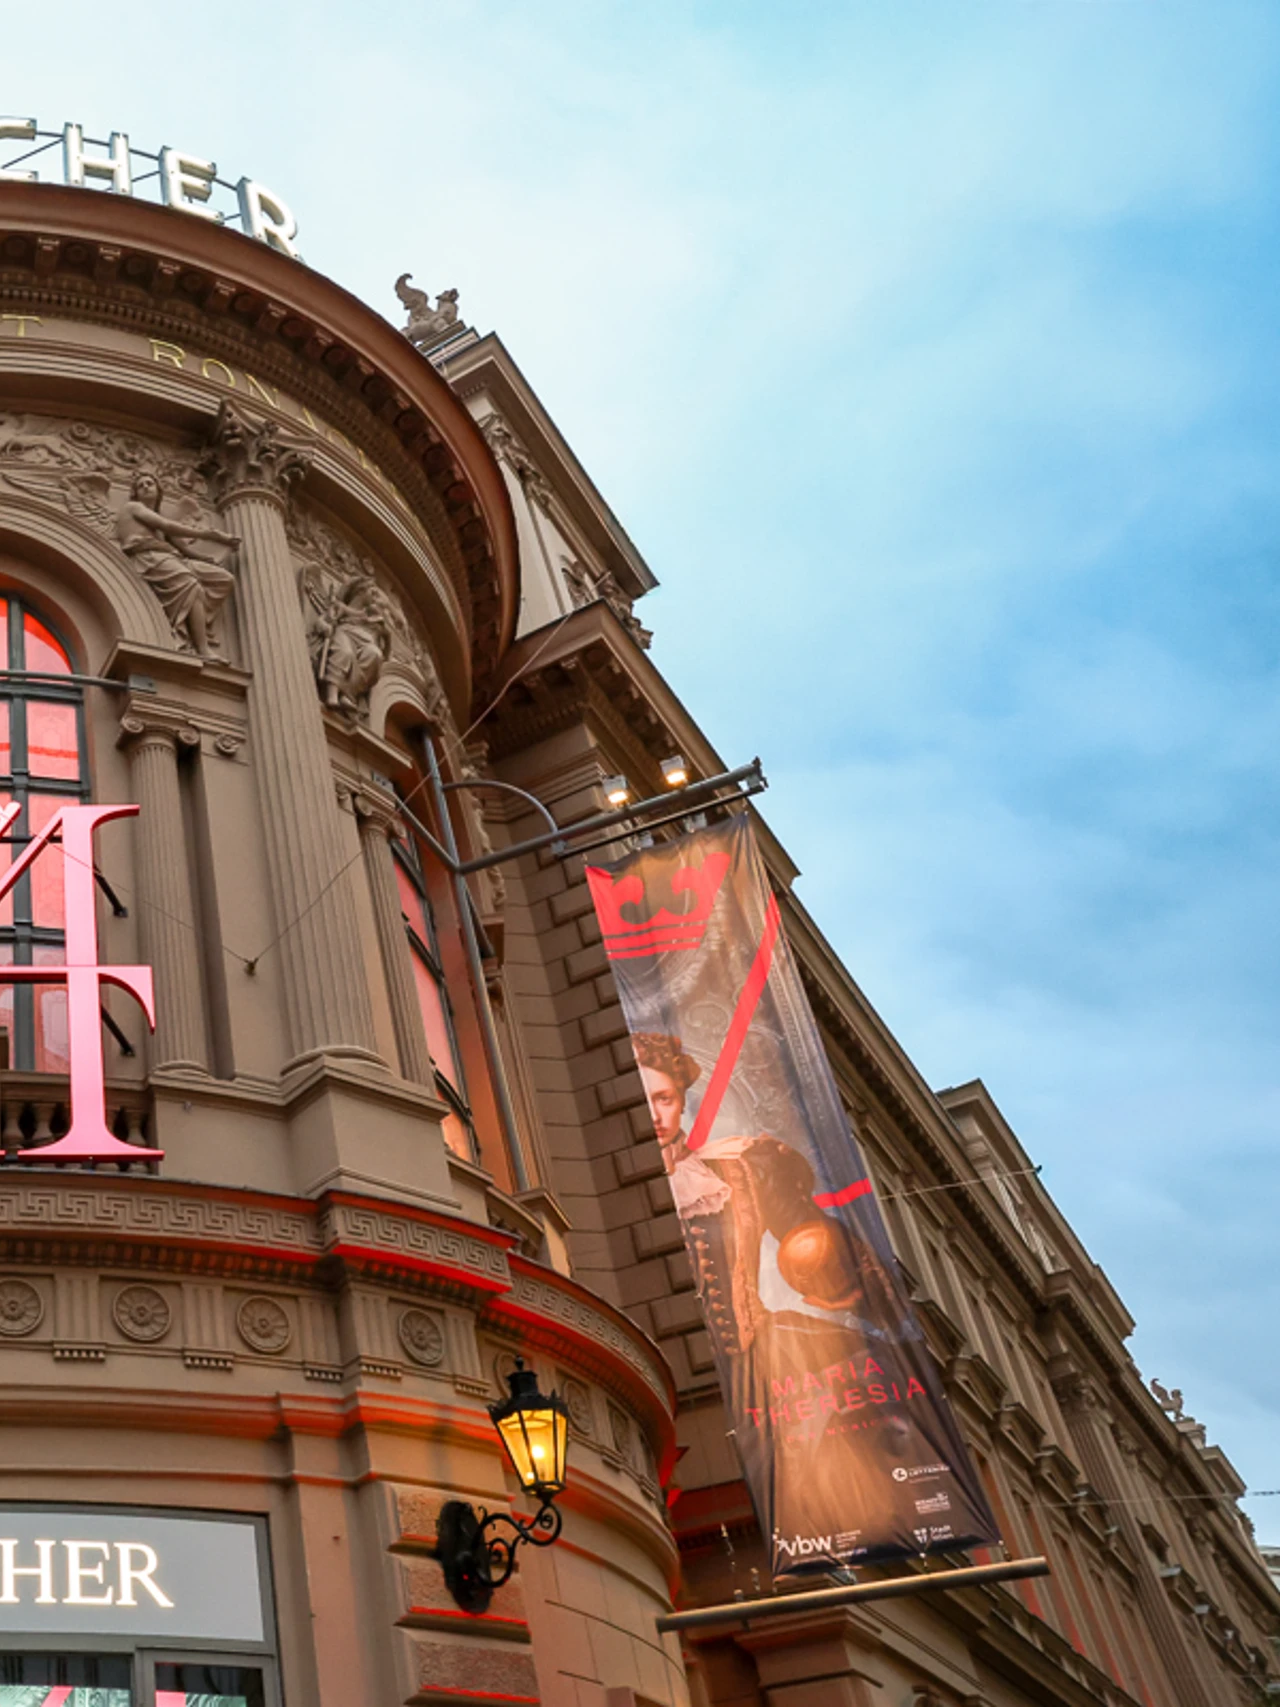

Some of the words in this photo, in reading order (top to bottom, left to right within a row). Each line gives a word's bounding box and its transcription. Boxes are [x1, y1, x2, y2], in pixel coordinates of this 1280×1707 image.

[772, 1357, 885, 1398] MARIA
[745, 1377, 927, 1428] THERESIA
[782, 1533, 832, 1557] vbw
